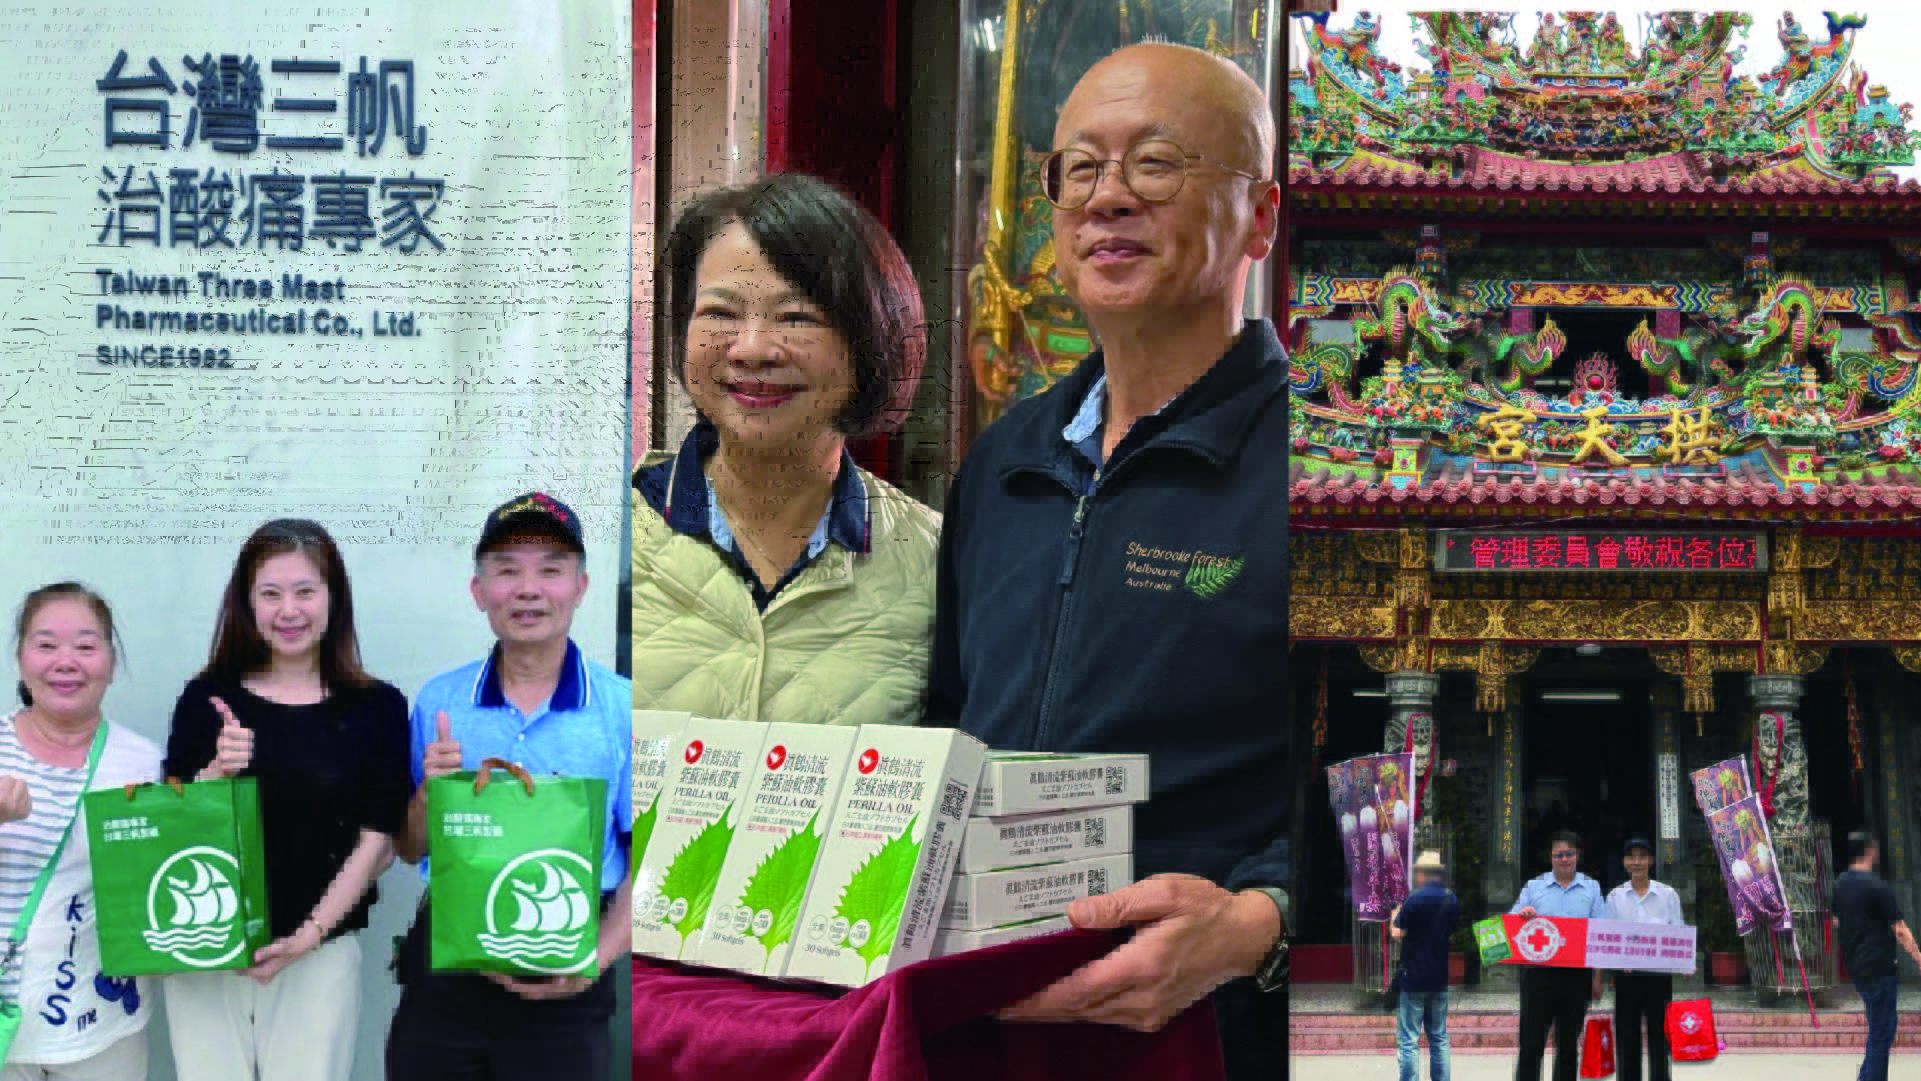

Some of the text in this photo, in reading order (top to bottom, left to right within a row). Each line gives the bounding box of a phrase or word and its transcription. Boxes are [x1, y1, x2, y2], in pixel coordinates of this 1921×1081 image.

[96, 49, 428, 158] 台灣三帆
[97, 164, 446, 254] 治酸痛專家
[96, 268, 346, 301] Taiwan Three Mast
[96, 303, 422, 339] Pharmaceutical Co., Ltd.
[1125, 541, 1191, 563] Sherbrooke
[1125, 560, 1182, 578] Melbourne
[674, 787, 732, 802] PERILLA OIL
[755, 793, 817, 809] PERILLA OIL
[847, 799, 914, 815] PERILLA OIL
[804, 943, 816, 952] 30
